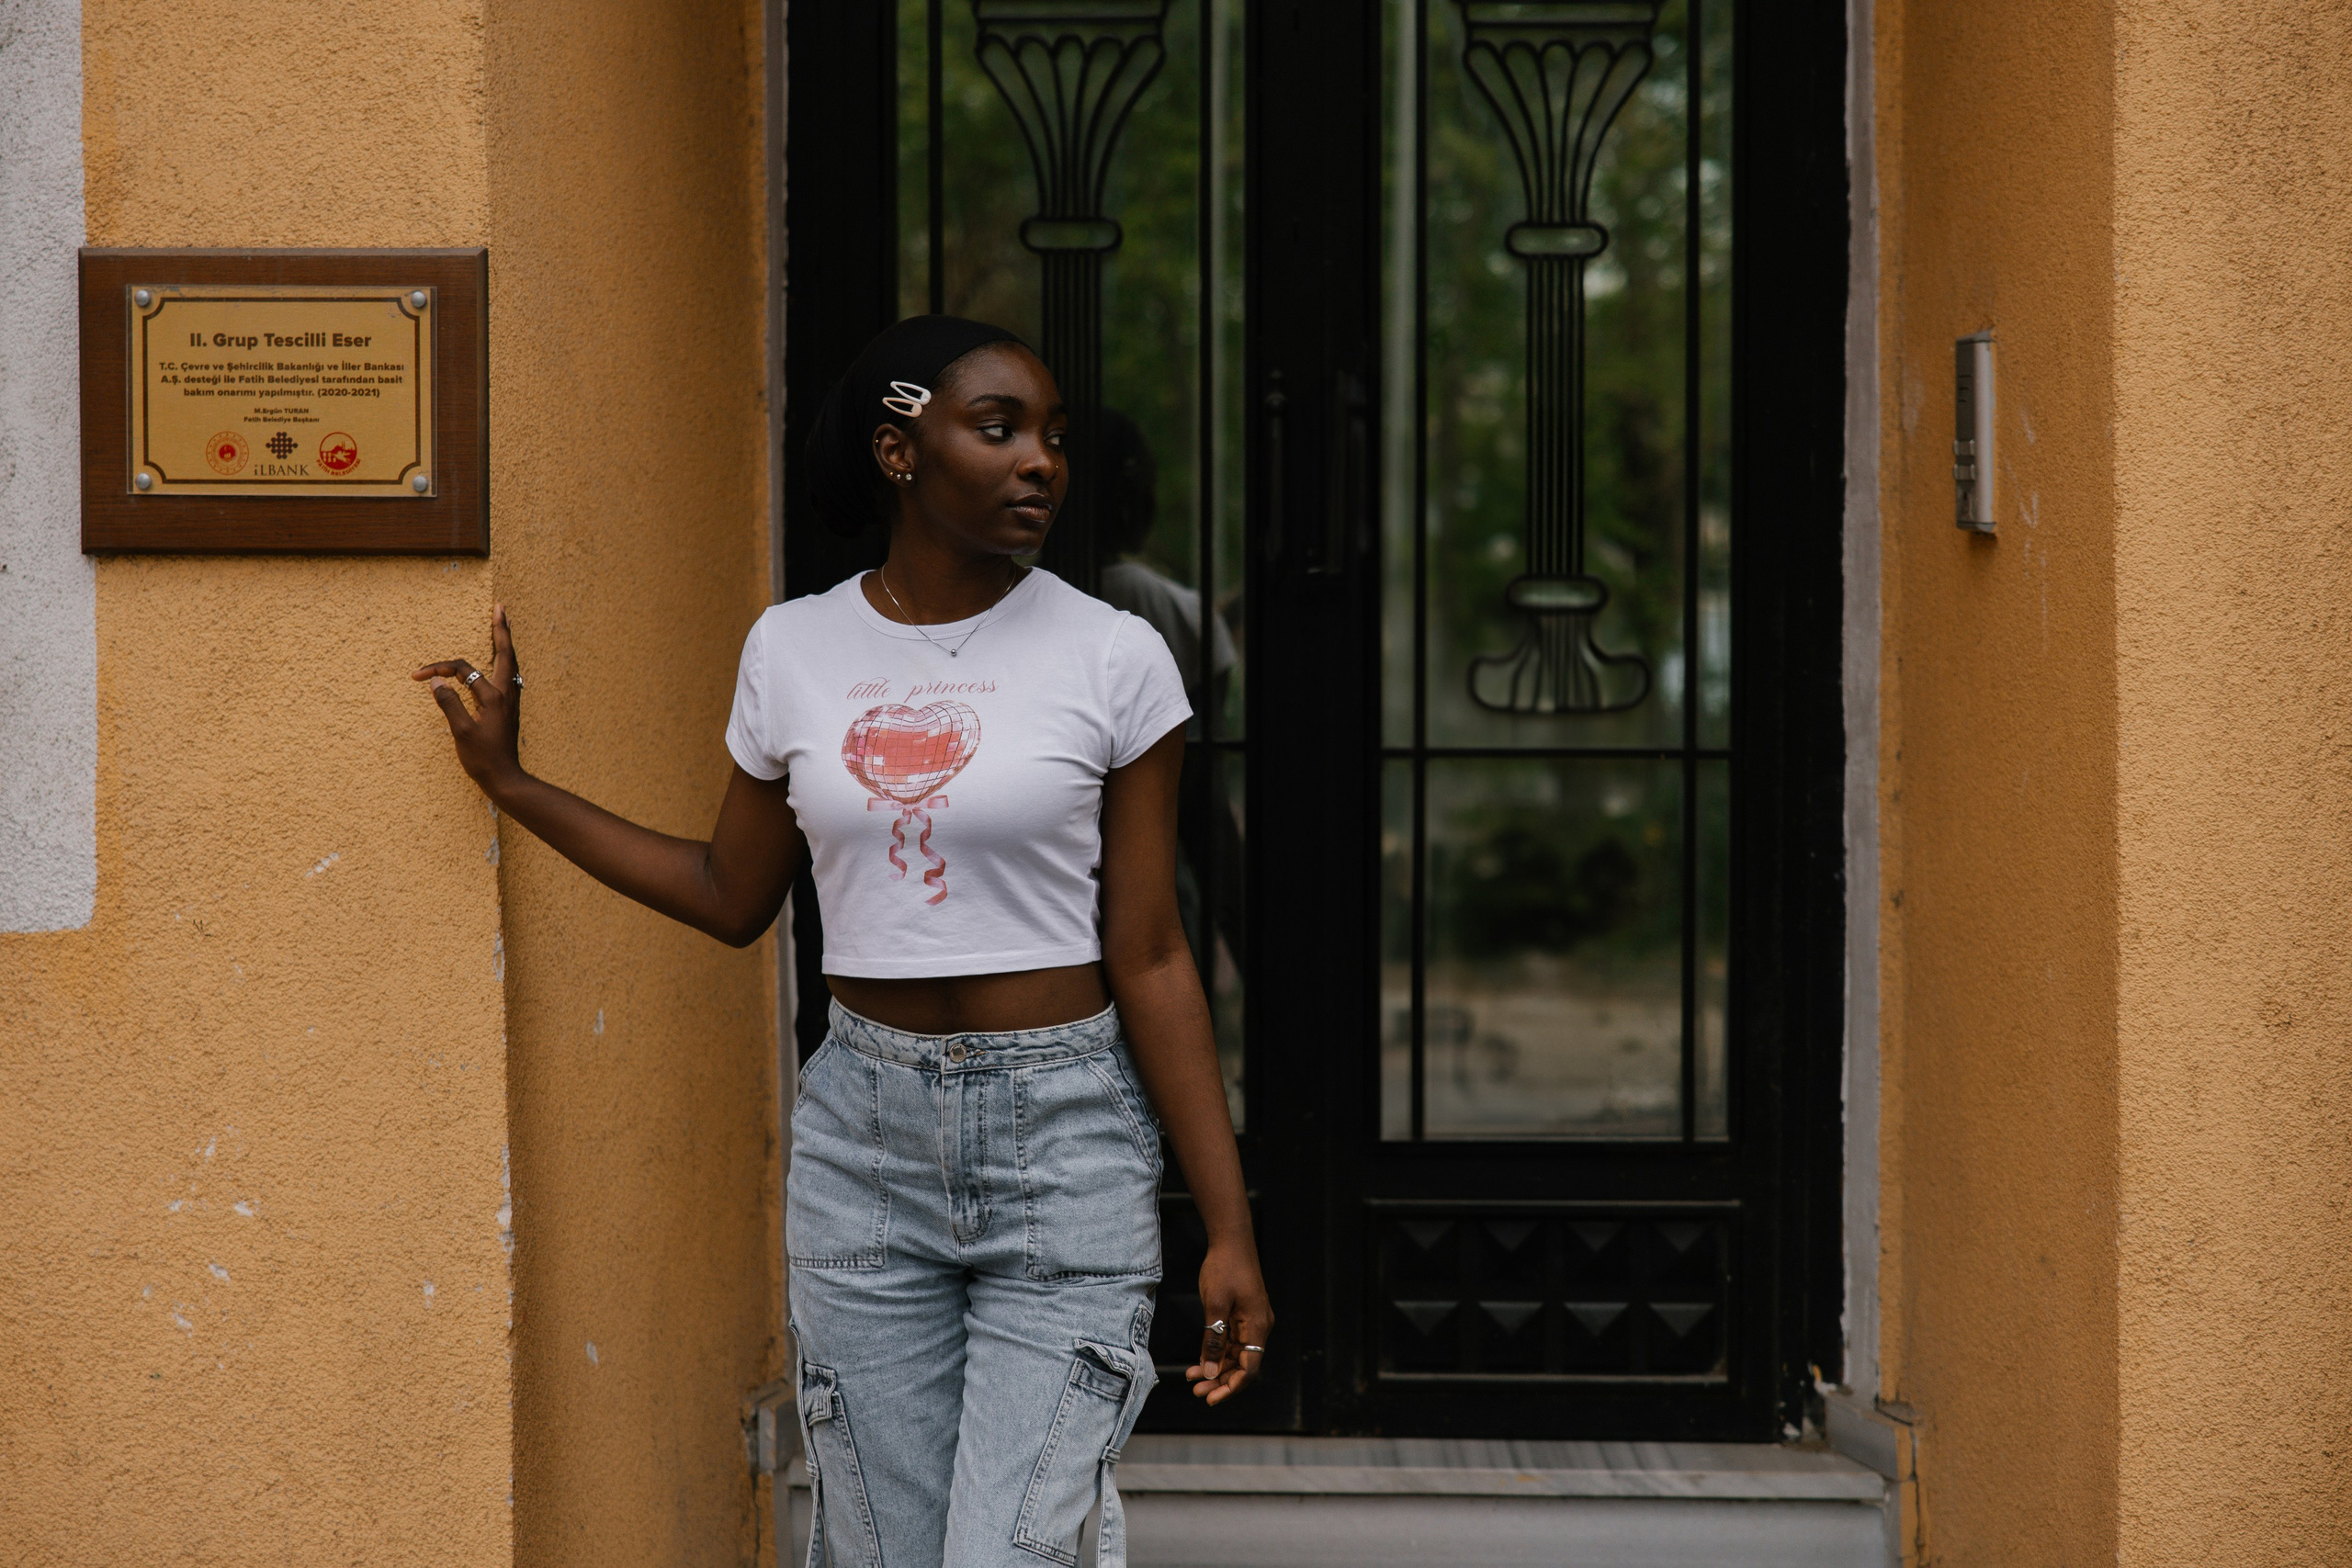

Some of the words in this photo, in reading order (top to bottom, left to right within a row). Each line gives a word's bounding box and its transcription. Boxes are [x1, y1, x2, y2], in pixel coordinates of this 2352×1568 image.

[189, 333, 208, 347] II.
[213, 333, 258, 350] Grup
[264, 333, 326, 347] Tescilli
[333, 333, 371, 347] Eser
[159, 362, 178, 370] T.C.
[181, 362, 209, 372] Çevre
[227, 362, 274, 372] Şehircilik
[277, 362, 323, 372] Bakanlığı
[341, 360, 361, 370] İller
[364, 362, 404, 370] Bankası
[161, 375, 181, 385] A.Ş.
[184, 375, 220, 384] desteği
[223, 375, 236, 383] ile
[239, 375, 265, 383] Fatih
[267, 375, 319, 384] Belediyesi
[322, 375, 375, 383] tarafından
[378, 375, 402, 383] basit
[184, 388, 214, 397] bakım
[218, 389, 256, 397] onarımı
[259, 388, 314, 398] yapılmıştır.
[317, 388, 380, 398] (2020-2021)
[846, 677, 891, 700] little
[903, 680, 999, 704] princess
